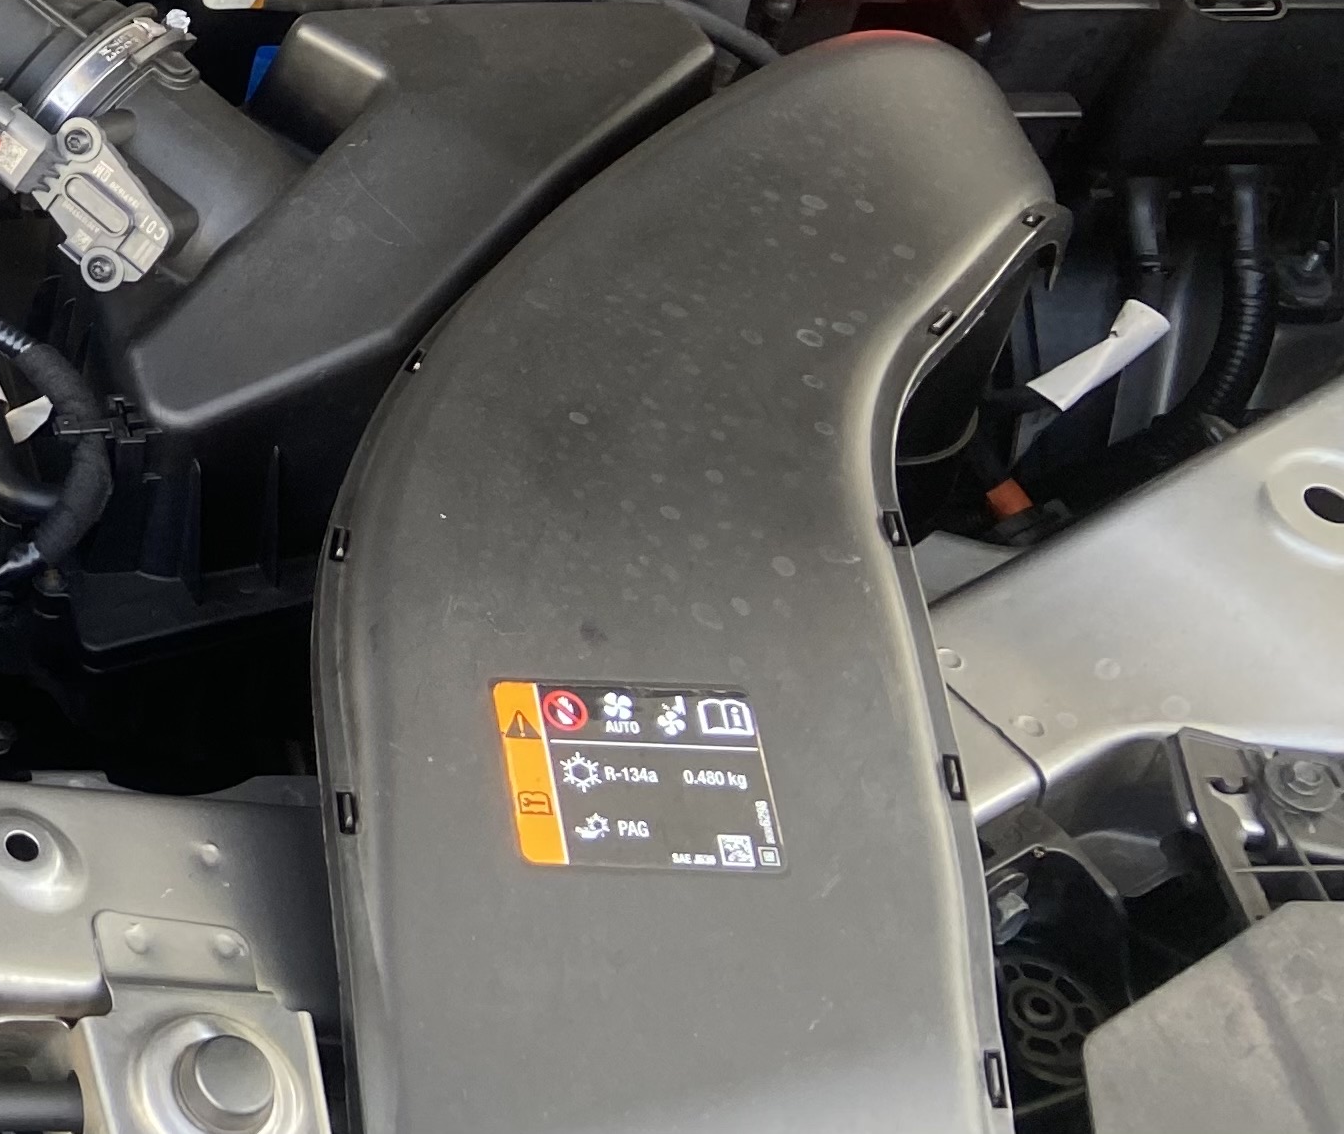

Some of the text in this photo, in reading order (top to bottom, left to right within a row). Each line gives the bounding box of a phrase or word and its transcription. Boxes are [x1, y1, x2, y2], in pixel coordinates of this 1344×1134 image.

[605, 720, 640, 734] AUTO
[604, 766, 748, 790] R-134a 0.480 kg
[617, 820, 650, 838] PAG
